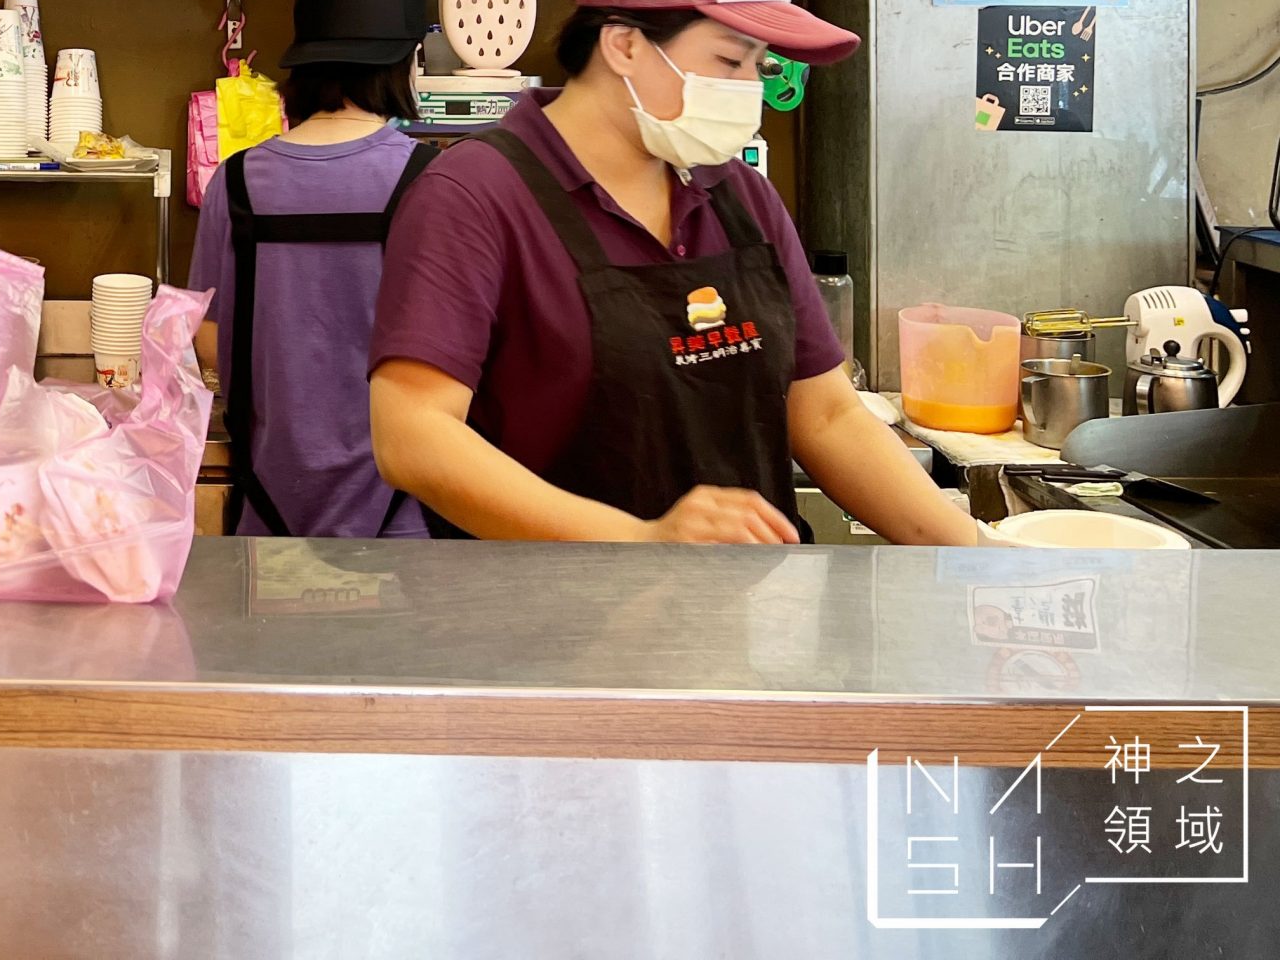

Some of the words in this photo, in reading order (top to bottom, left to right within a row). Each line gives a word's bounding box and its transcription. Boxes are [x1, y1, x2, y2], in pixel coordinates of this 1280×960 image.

[1008, 15, 1066, 36] Uber
[1008, 38, 1065, 58] Eats
[996, 62, 1076, 82] 合作商家
